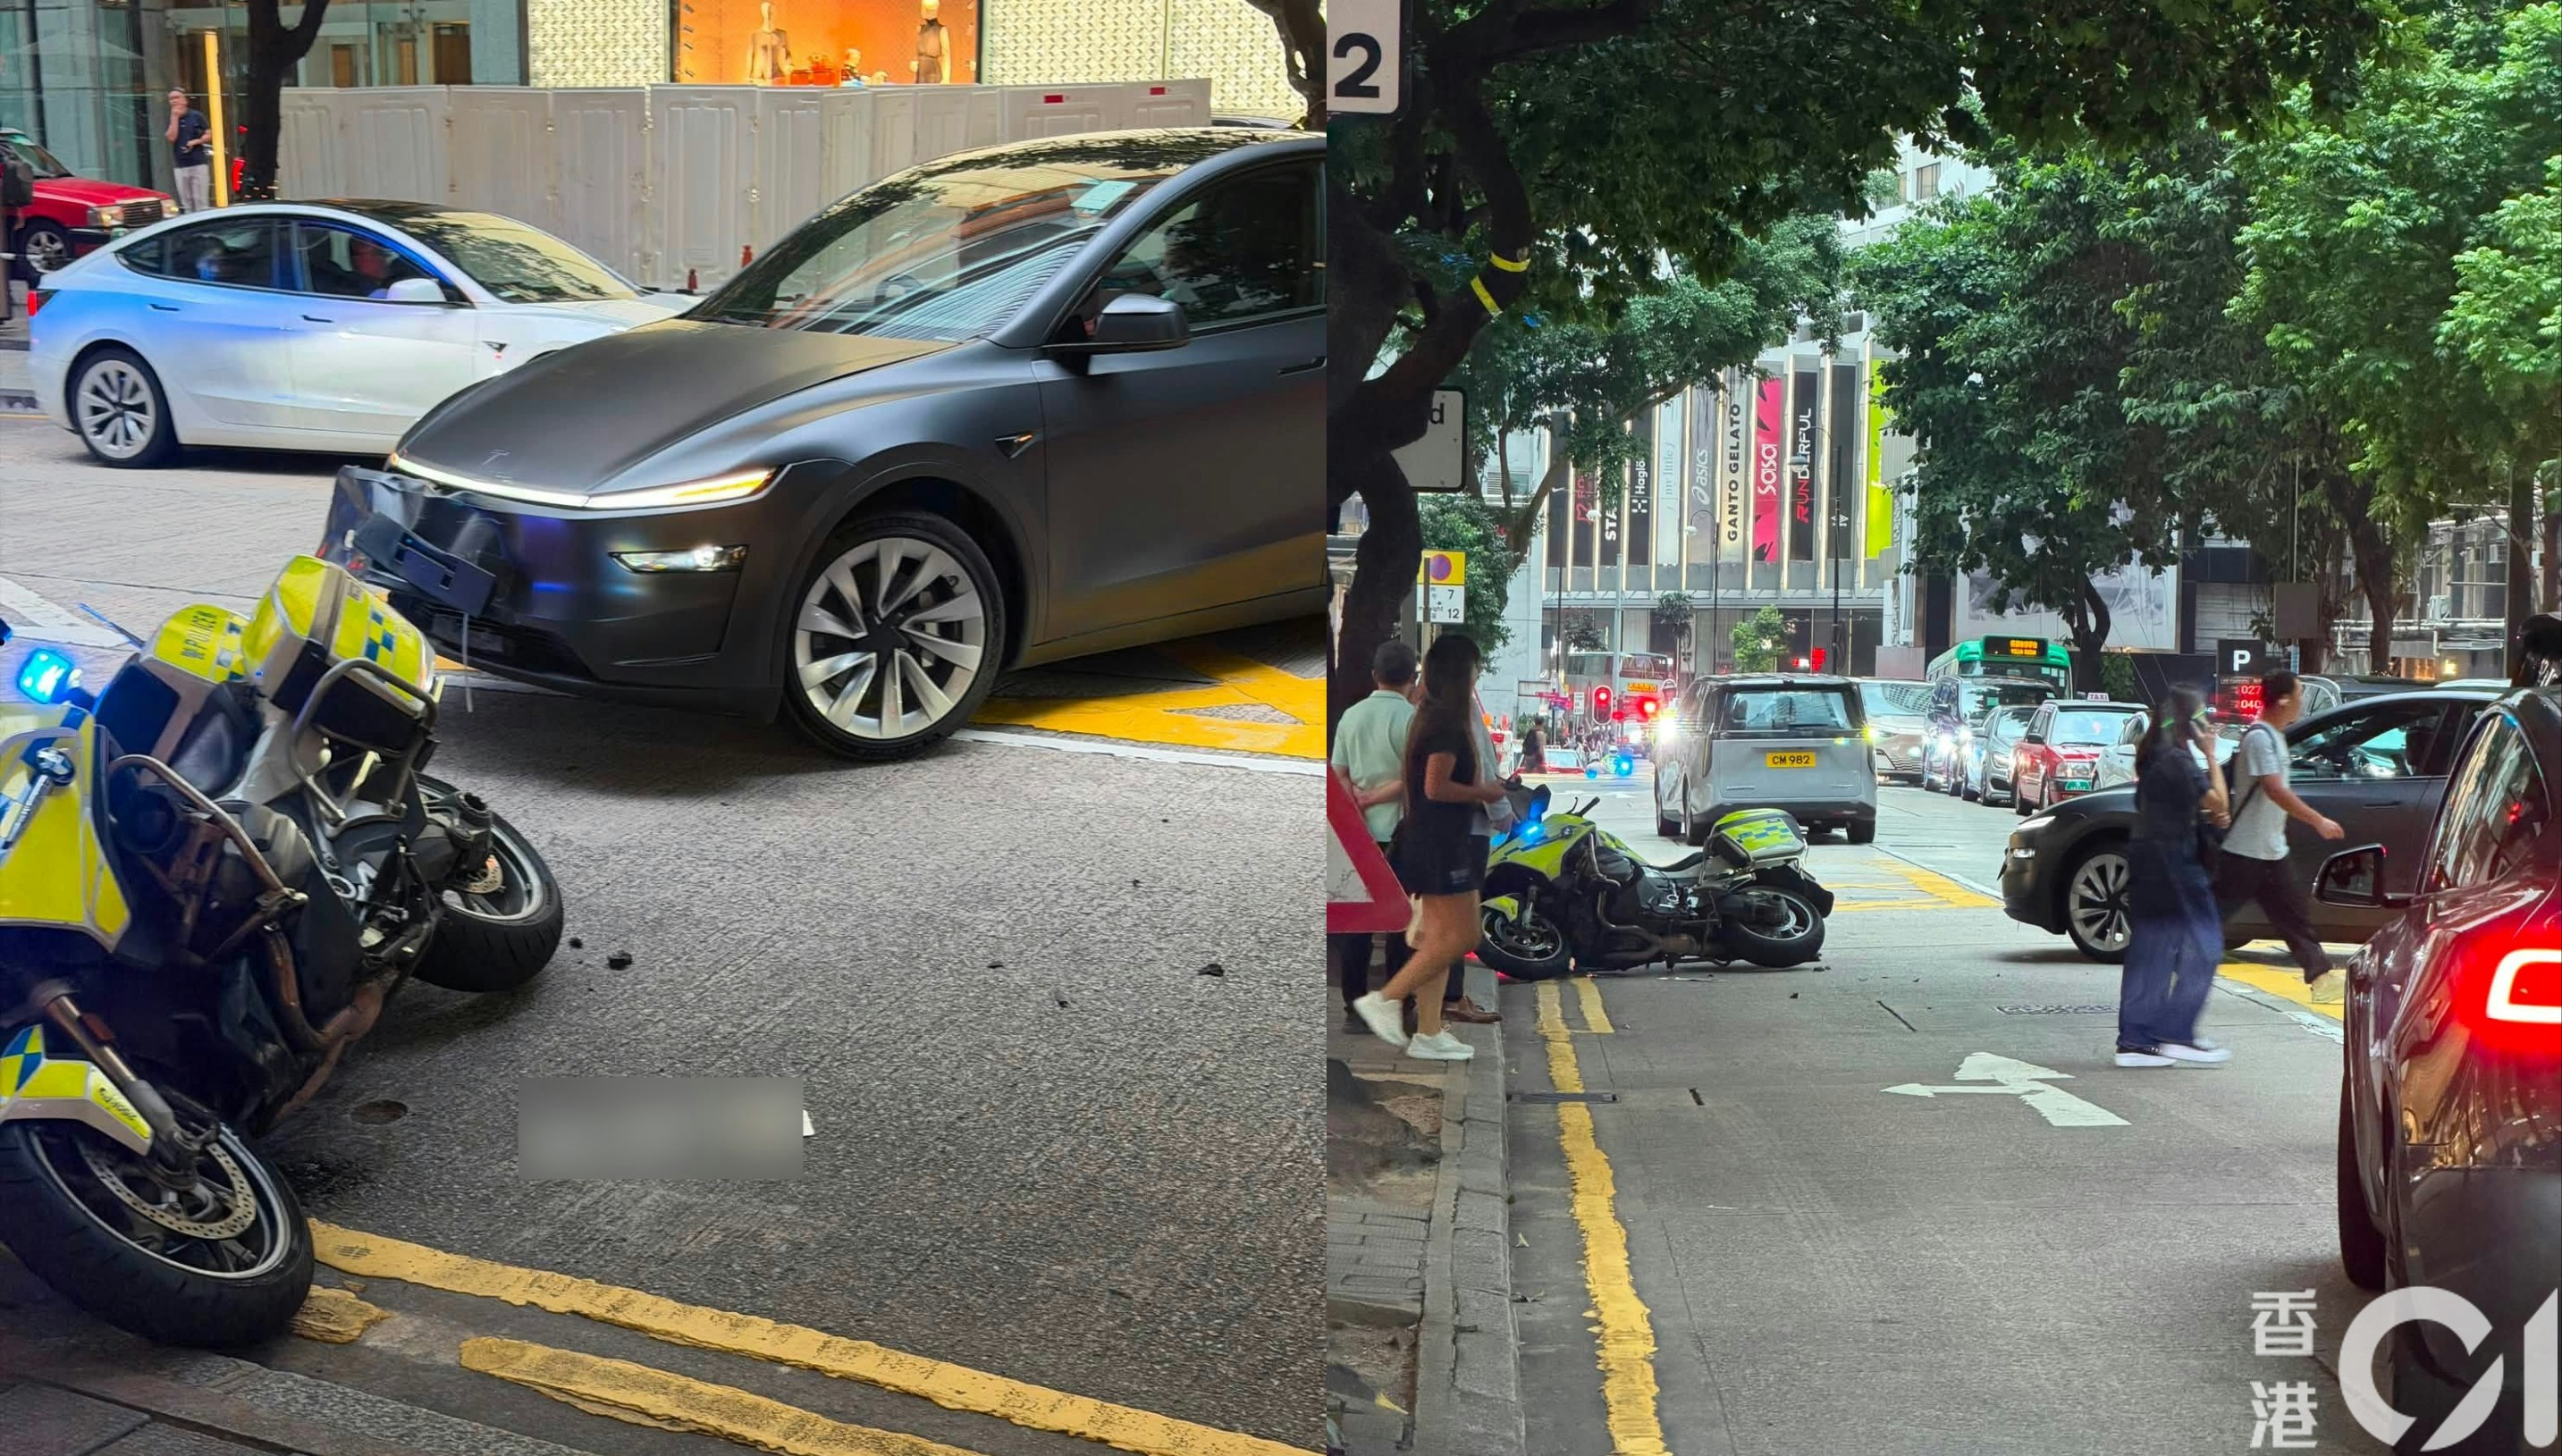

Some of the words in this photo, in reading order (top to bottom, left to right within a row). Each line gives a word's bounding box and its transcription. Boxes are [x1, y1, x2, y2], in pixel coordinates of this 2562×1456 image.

[1333, 32, 1382, 98] 2
[1430, 402, 1445, 425] d
[1729, 404, 1741, 474] GELATO
[1634, 459, 1648, 495] Haglö
[1728, 480, 1740, 542] GANTO
[1447, 589, 1454, 600] 7
[1447, 608, 1460, 619] 12
[2233, 650, 2251, 671] P
[1772, 755, 1787, 765] CM
[1789, 754, 1810, 765] 982
